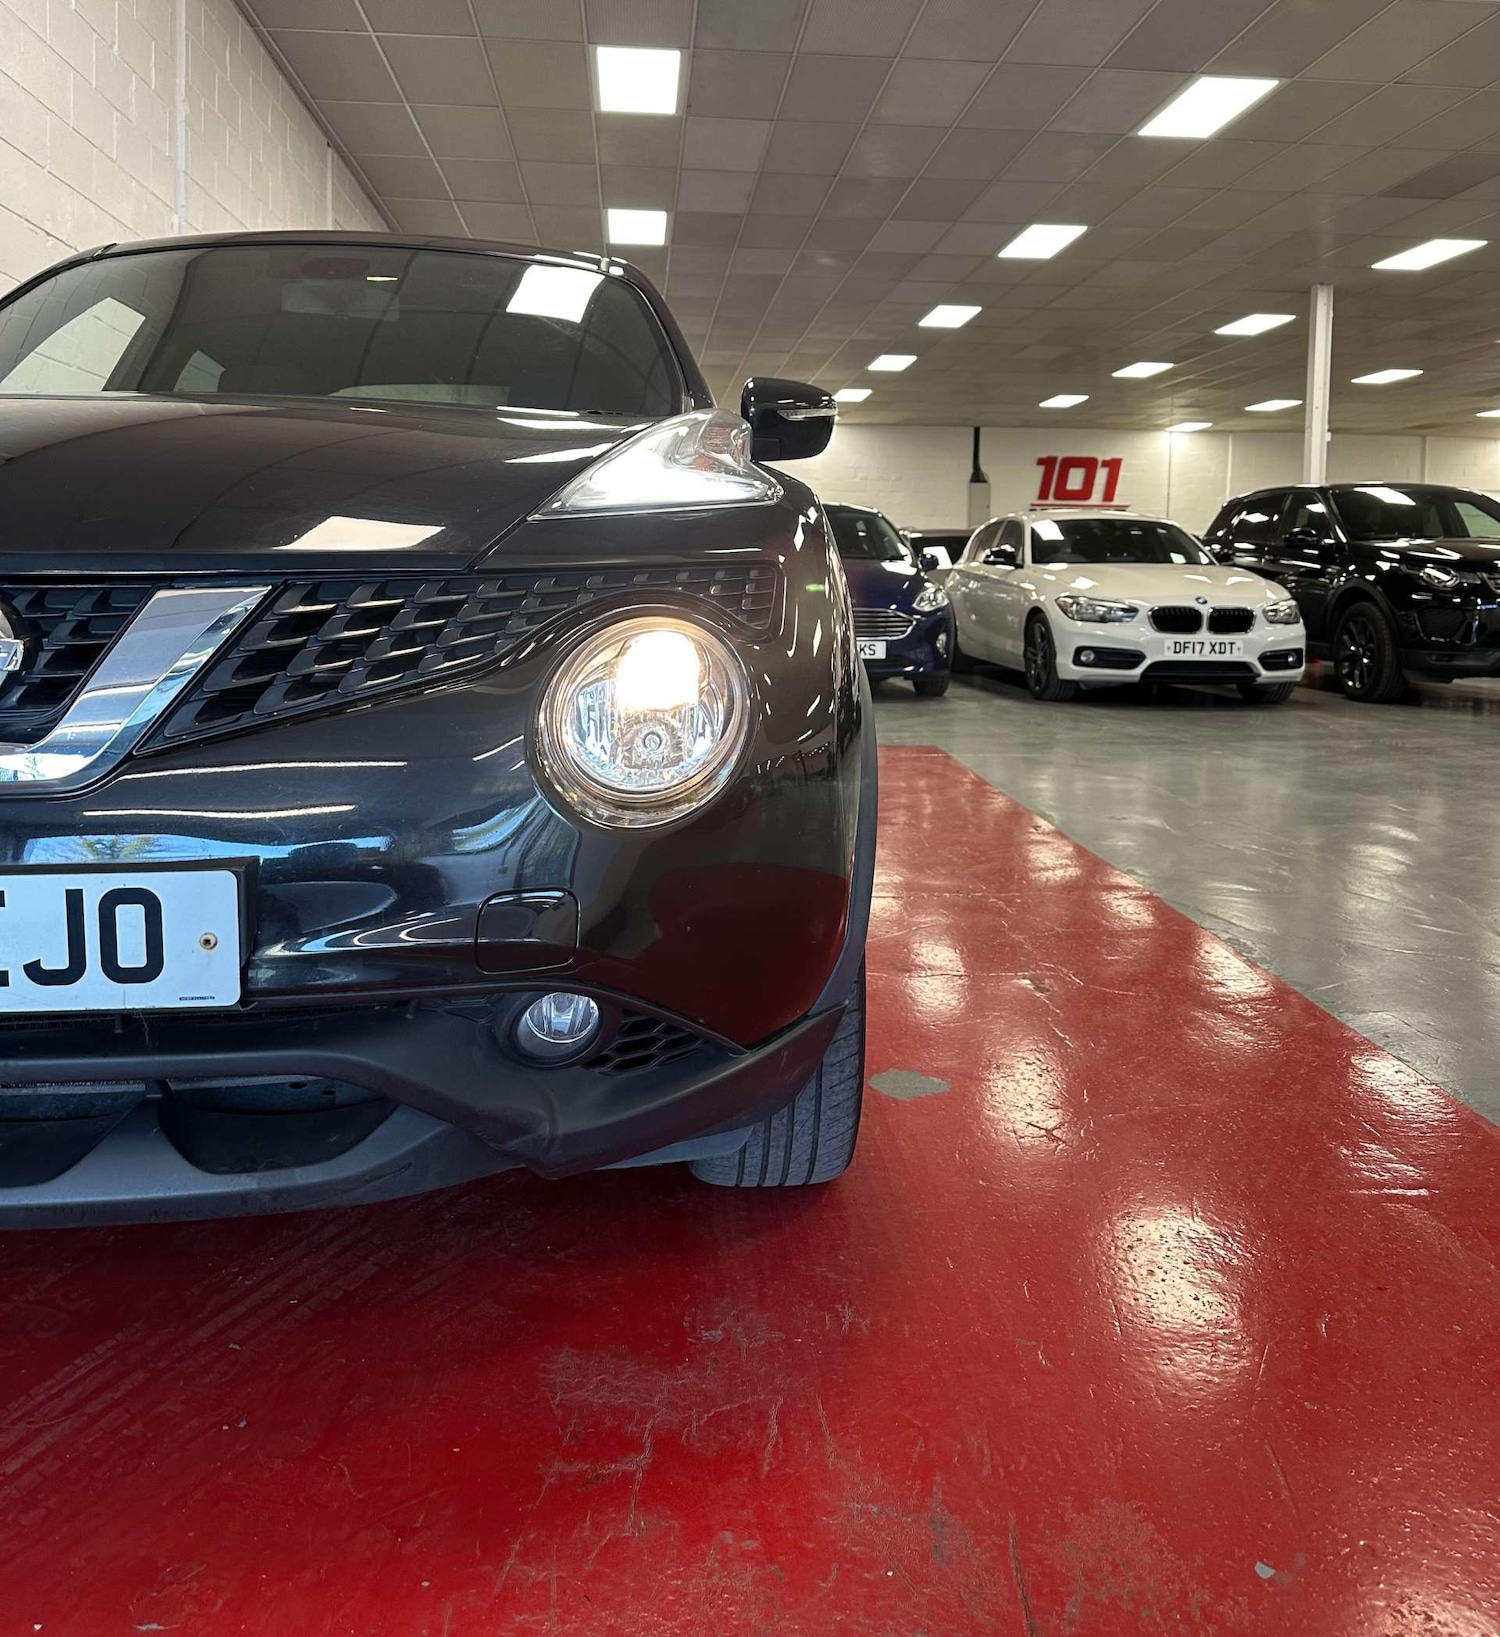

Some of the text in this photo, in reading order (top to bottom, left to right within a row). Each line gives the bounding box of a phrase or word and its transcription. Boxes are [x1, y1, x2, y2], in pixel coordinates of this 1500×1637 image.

[1036, 455, 1122, 502] 101
[1173, 641, 1236, 655] DF17 XDT
[0, 887, 164, 987] JO
